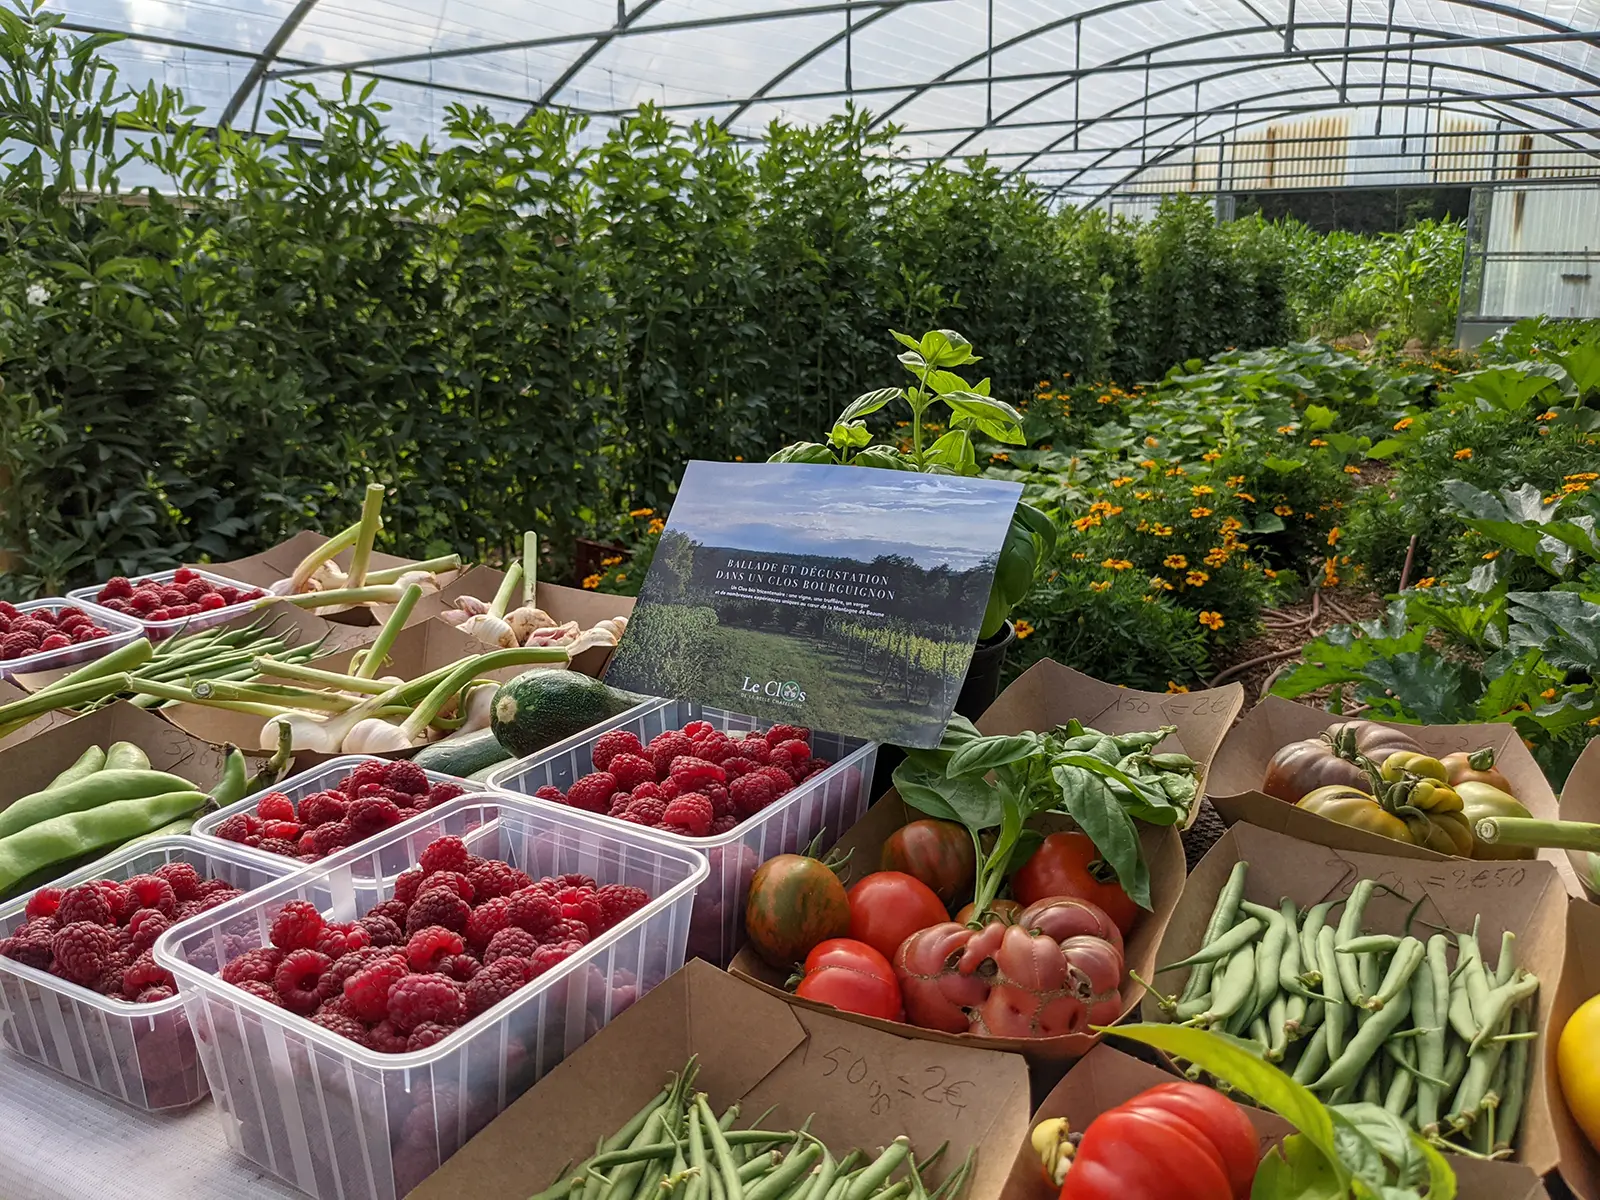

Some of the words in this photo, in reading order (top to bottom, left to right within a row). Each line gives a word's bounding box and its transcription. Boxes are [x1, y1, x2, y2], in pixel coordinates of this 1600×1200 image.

[727, 559, 778, 572] BALLADE
[782, 564, 797, 574] ET
[800, 566, 890, 586] DÉGUSTATION
[716, 570, 744, 581] DANS
[748, 574, 764, 583] UN
[768, 576, 798, 588] CLOS
[802, 580, 896, 600] BOURGUIGNON
[833, 606, 858, 614] Montagne
[741, 676, 760, 693] Le
[1114, 694, 1150, 714] 150
